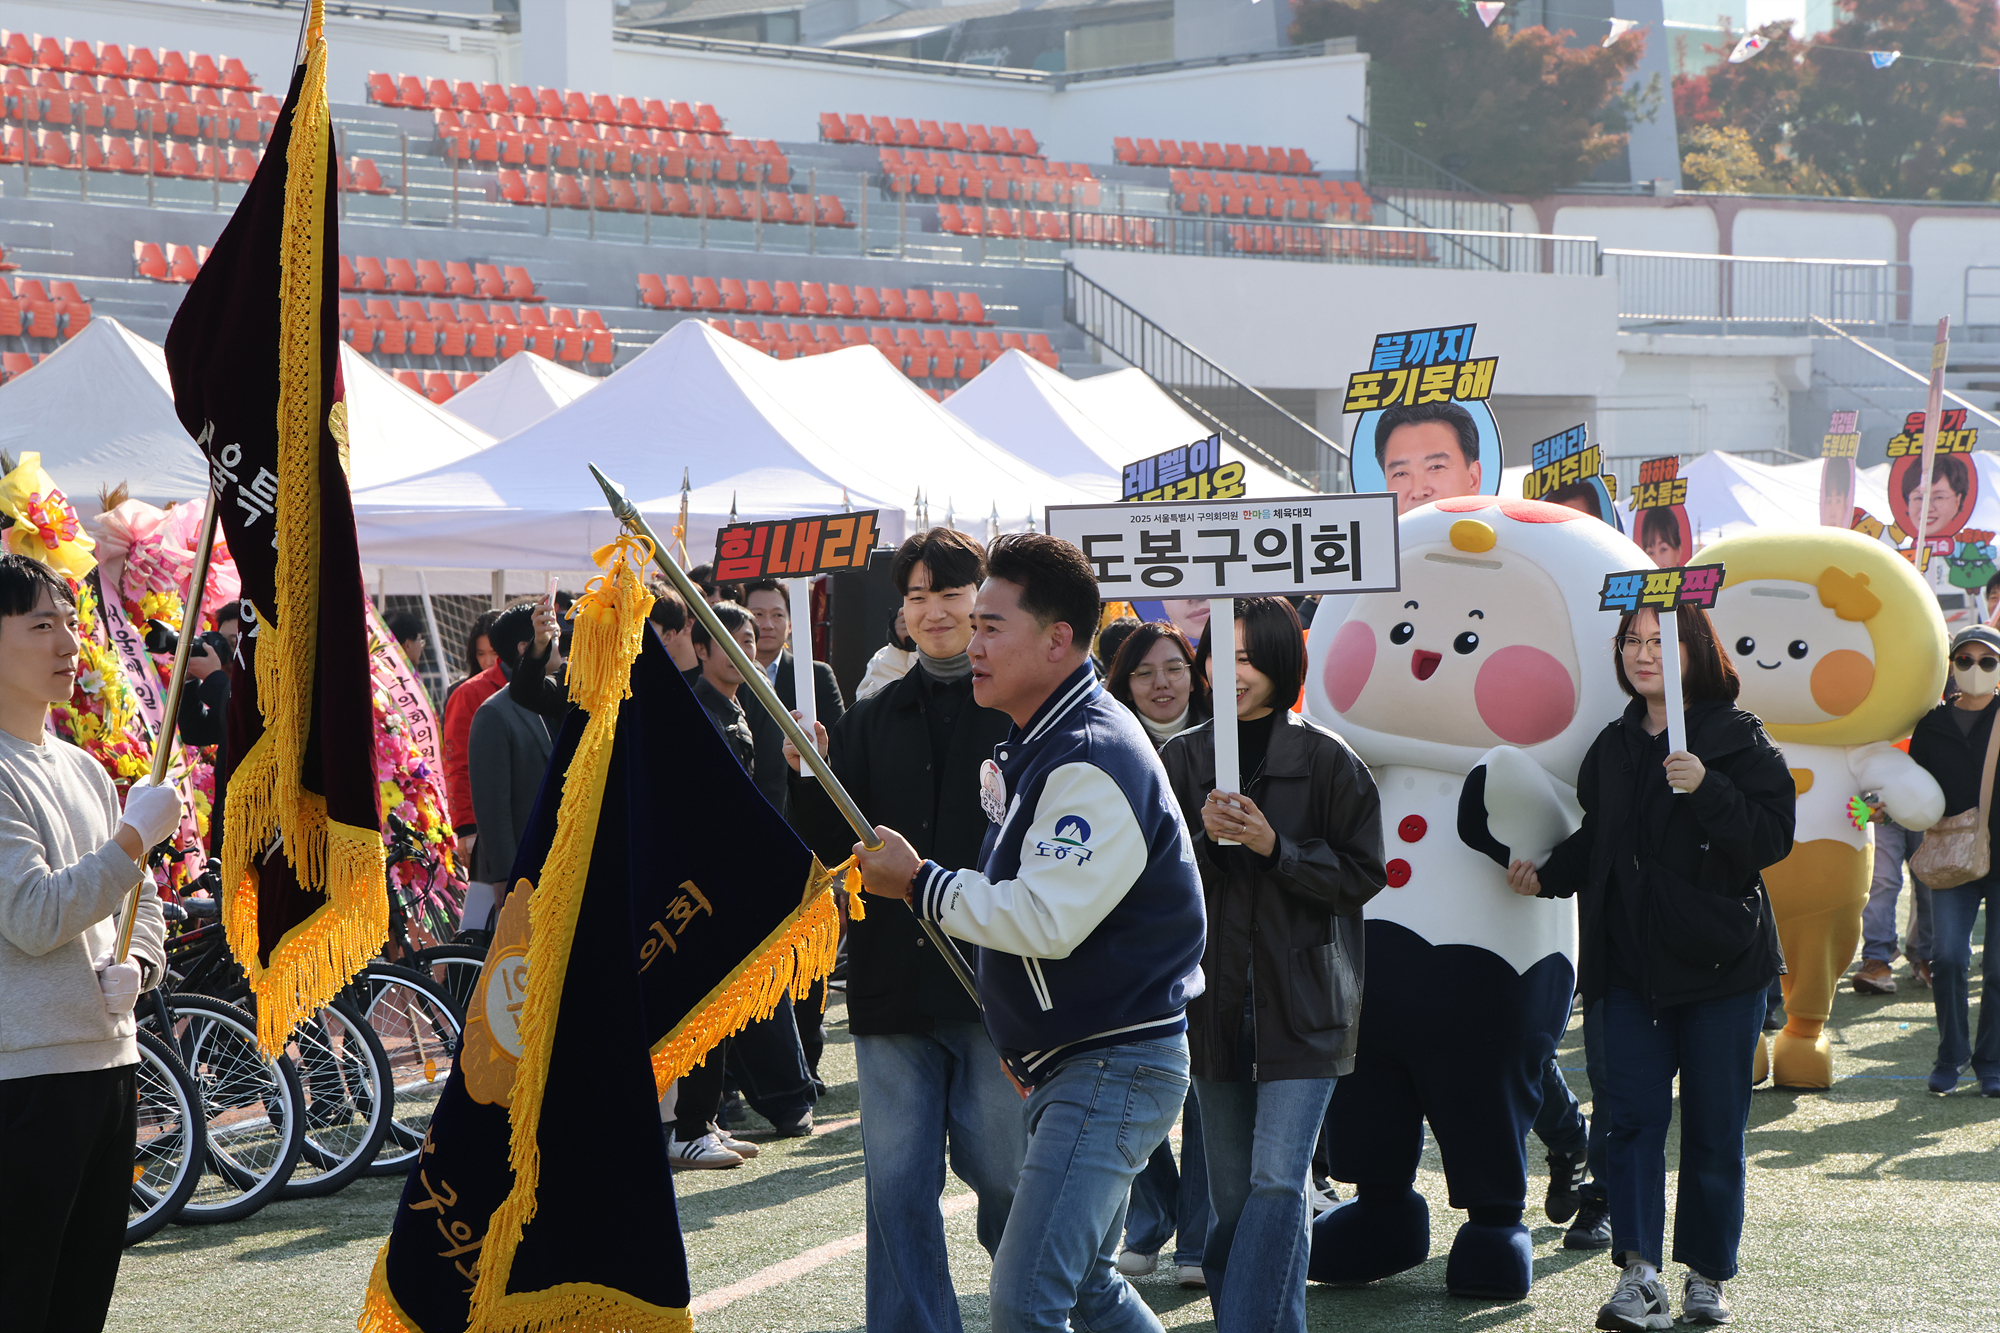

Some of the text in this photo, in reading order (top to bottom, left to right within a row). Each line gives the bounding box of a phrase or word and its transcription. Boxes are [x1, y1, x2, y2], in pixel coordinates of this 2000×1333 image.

[1371, 326, 1474, 371] 끝까지
[1345, 359, 1496, 411] 포기못해
[1829, 411, 1856, 433] 최강팀
[1905, 409, 1966, 433] 우가
[1124, 435, 1218, 498] 레벨이
[1532, 425, 1587, 471] 덤벼라
[1821, 433, 1858, 458] 도봉의회
[1523, 445, 1600, 500] 이겨주마
[1639, 457, 1679, 484] 하하하
[1130, 507, 1312, 523] 2025 서울특별시 구의회의원 한마음 체육대회
[716, 515, 875, 581] 힘내라
[1082, 521, 1362, 588] 도봉구의회
[1604, 568, 1721, 611] 짝짝짝
[1035, 841, 1093, 867] 도봉구
